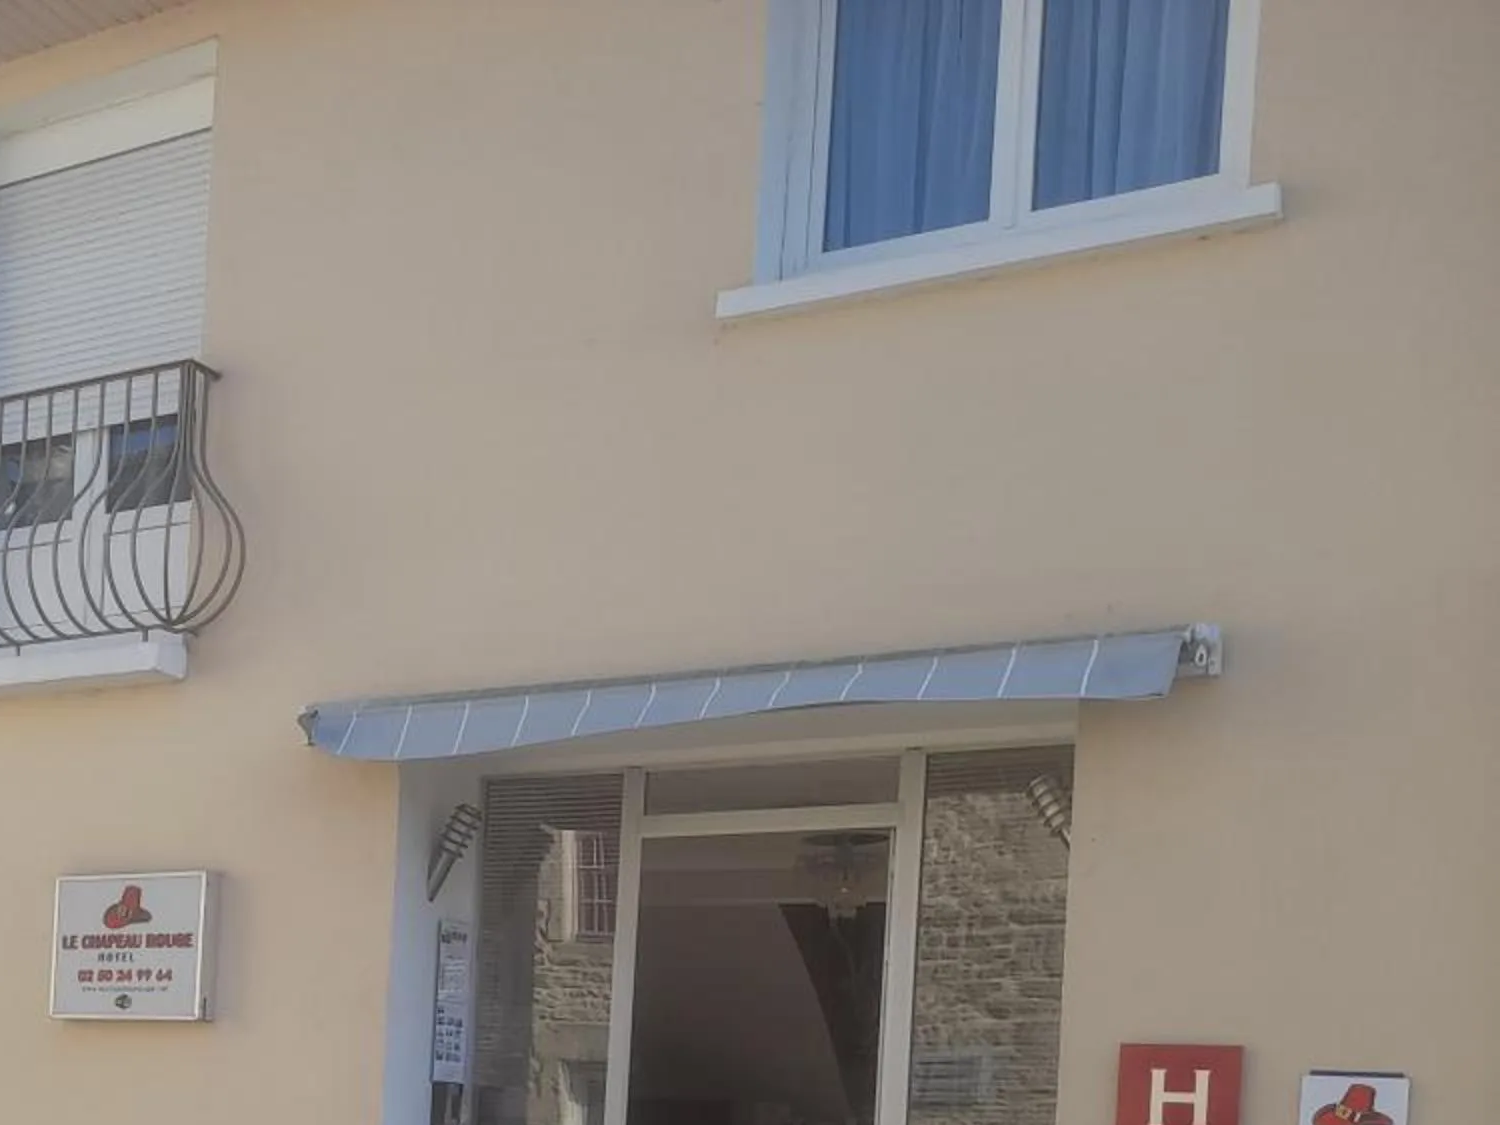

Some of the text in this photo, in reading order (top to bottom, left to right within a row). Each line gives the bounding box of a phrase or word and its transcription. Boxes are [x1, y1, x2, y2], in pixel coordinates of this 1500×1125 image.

[62, 932, 194, 950] LE CHAPEAU ROUGE
[77, 969, 94, 982] 02
[136, 968, 153, 982] 99
[155, 967, 173, 982] 64
